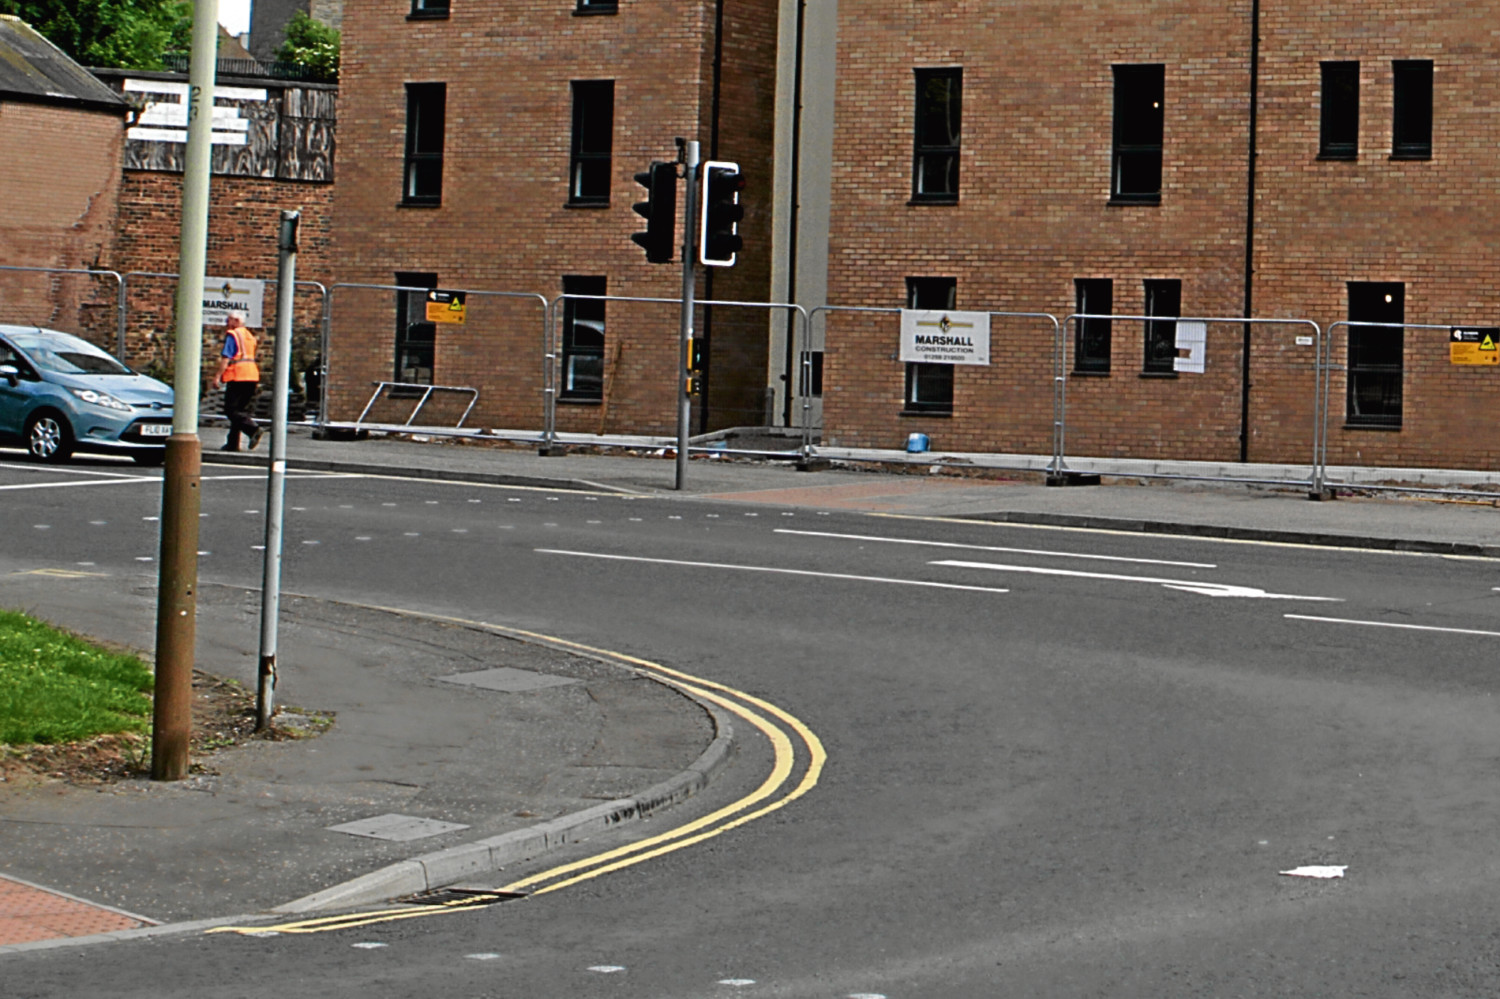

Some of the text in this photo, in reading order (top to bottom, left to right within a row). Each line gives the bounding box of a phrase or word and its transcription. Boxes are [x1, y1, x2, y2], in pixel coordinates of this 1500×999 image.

[202, 300, 249, 311] MARSHALL
[915, 335, 973, 346] MARSHALL
[915, 345, 974, 353] CONSTRUCTION
